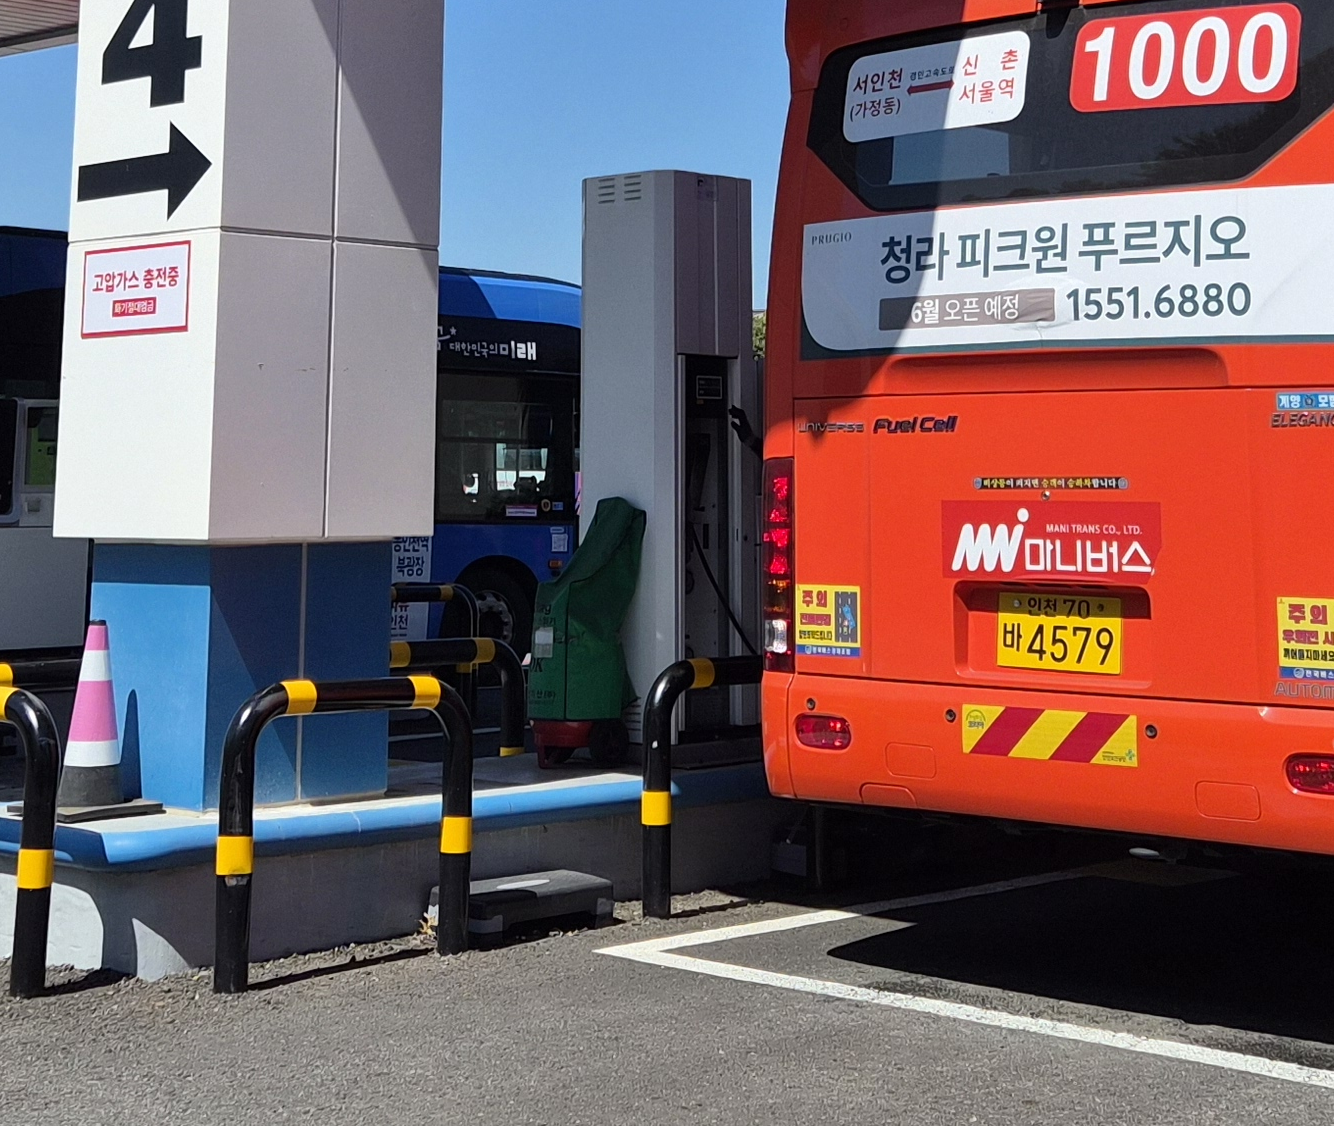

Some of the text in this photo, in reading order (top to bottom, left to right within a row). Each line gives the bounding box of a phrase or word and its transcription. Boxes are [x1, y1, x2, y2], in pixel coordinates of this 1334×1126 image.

[1083, 11, 1288, 103] 1000
[852, 68, 903, 95] 서인천
[958, 77, 1015, 104] 서울역
[849, 97, 901, 122] (가정동)
[811, 231, 852, 246] PRUGIO
[879, 213, 1251, 285] 청라 피크원 푸르지오
[92, 266, 179, 293] 고압가스 충전중
[910, 295, 1020, 325] 6월 오픈 예정
[1066, 281, 1252, 322] 1551.6880
[873, 416, 918, 434] Fuel
[919, 415, 958, 433] Cell
[1046, 524, 1069, 533] MANI
[1072, 525, 1100, 534] TRANS
[1123, 525, 1143, 535] LTD.
[396, 556, 424, 577] 북광장
[1025, 538, 1152, 573] 마니버스
[1027, 597, 1090, 619] 인천 70
[1003, 623, 1114, 665] 바 4579
[1283, 629, 1319, 645] 우회전
